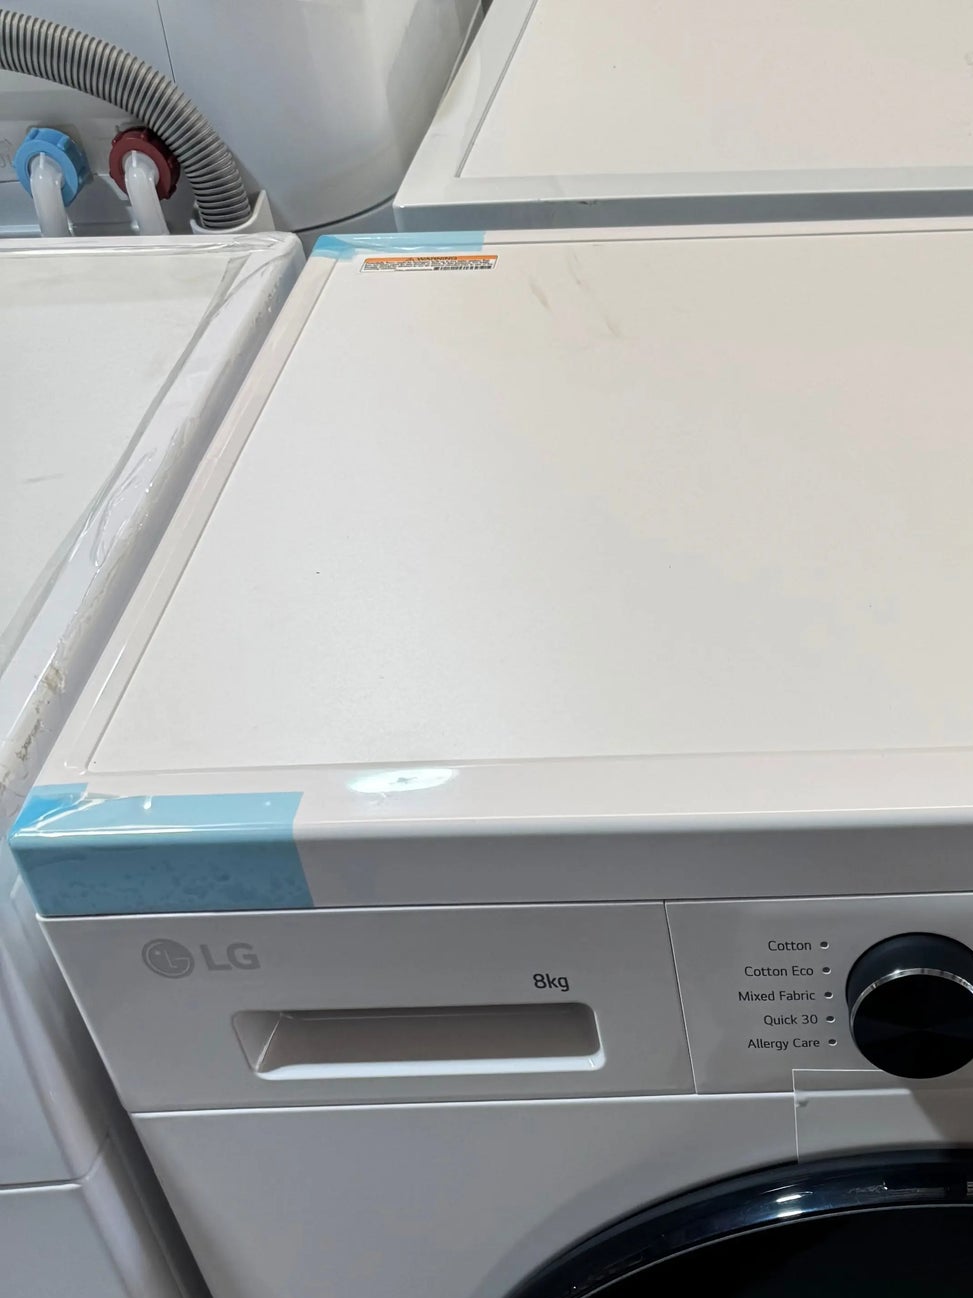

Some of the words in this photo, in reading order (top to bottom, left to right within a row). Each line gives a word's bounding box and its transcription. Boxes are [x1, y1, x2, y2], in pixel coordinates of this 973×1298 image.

[767, 940, 812, 952] Cotton
[201, 942, 261, 972] LG
[744, 965, 788, 977] Cotton
[791, 965, 814, 977] Eco
[532, 973, 571, 992] 8kg
[738, 990, 777, 1002] Mixed
[779, 990, 816, 1001] Fabric
[763, 1014, 798, 1027] Quick
[800, 1014, 818, 1025] 30
[748, 1038, 789, 1051] Allergy
[792, 1037, 820, 1049] Care
